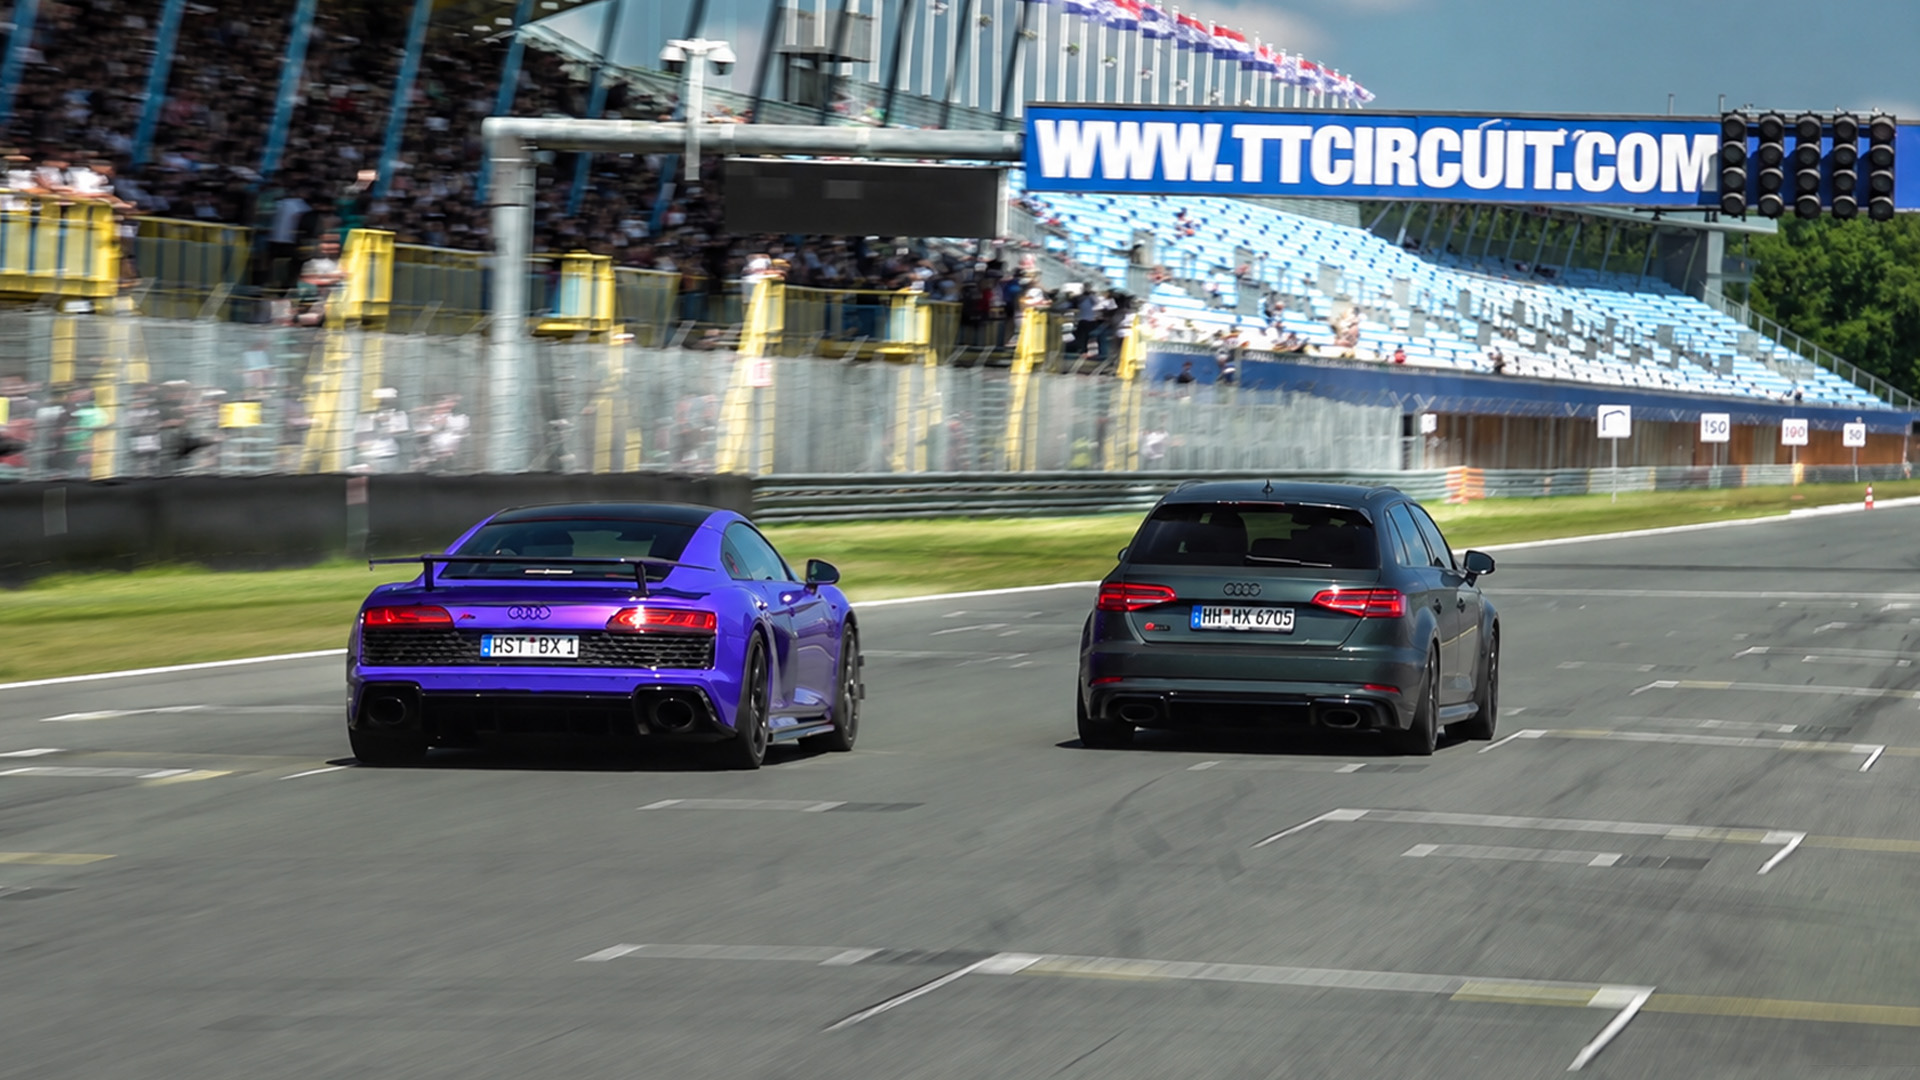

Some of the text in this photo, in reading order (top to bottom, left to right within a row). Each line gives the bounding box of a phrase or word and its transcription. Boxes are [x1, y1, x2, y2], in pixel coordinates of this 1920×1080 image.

[1034, 119, 1718, 194] WWW.TTCIRCUIT.COM
[1704, 420, 1727, 434] 150
[1849, 429, 1862, 440] 50
[1202, 608, 1293, 626] HH HX 6705
[493, 637, 575, 655] HST BX 1
